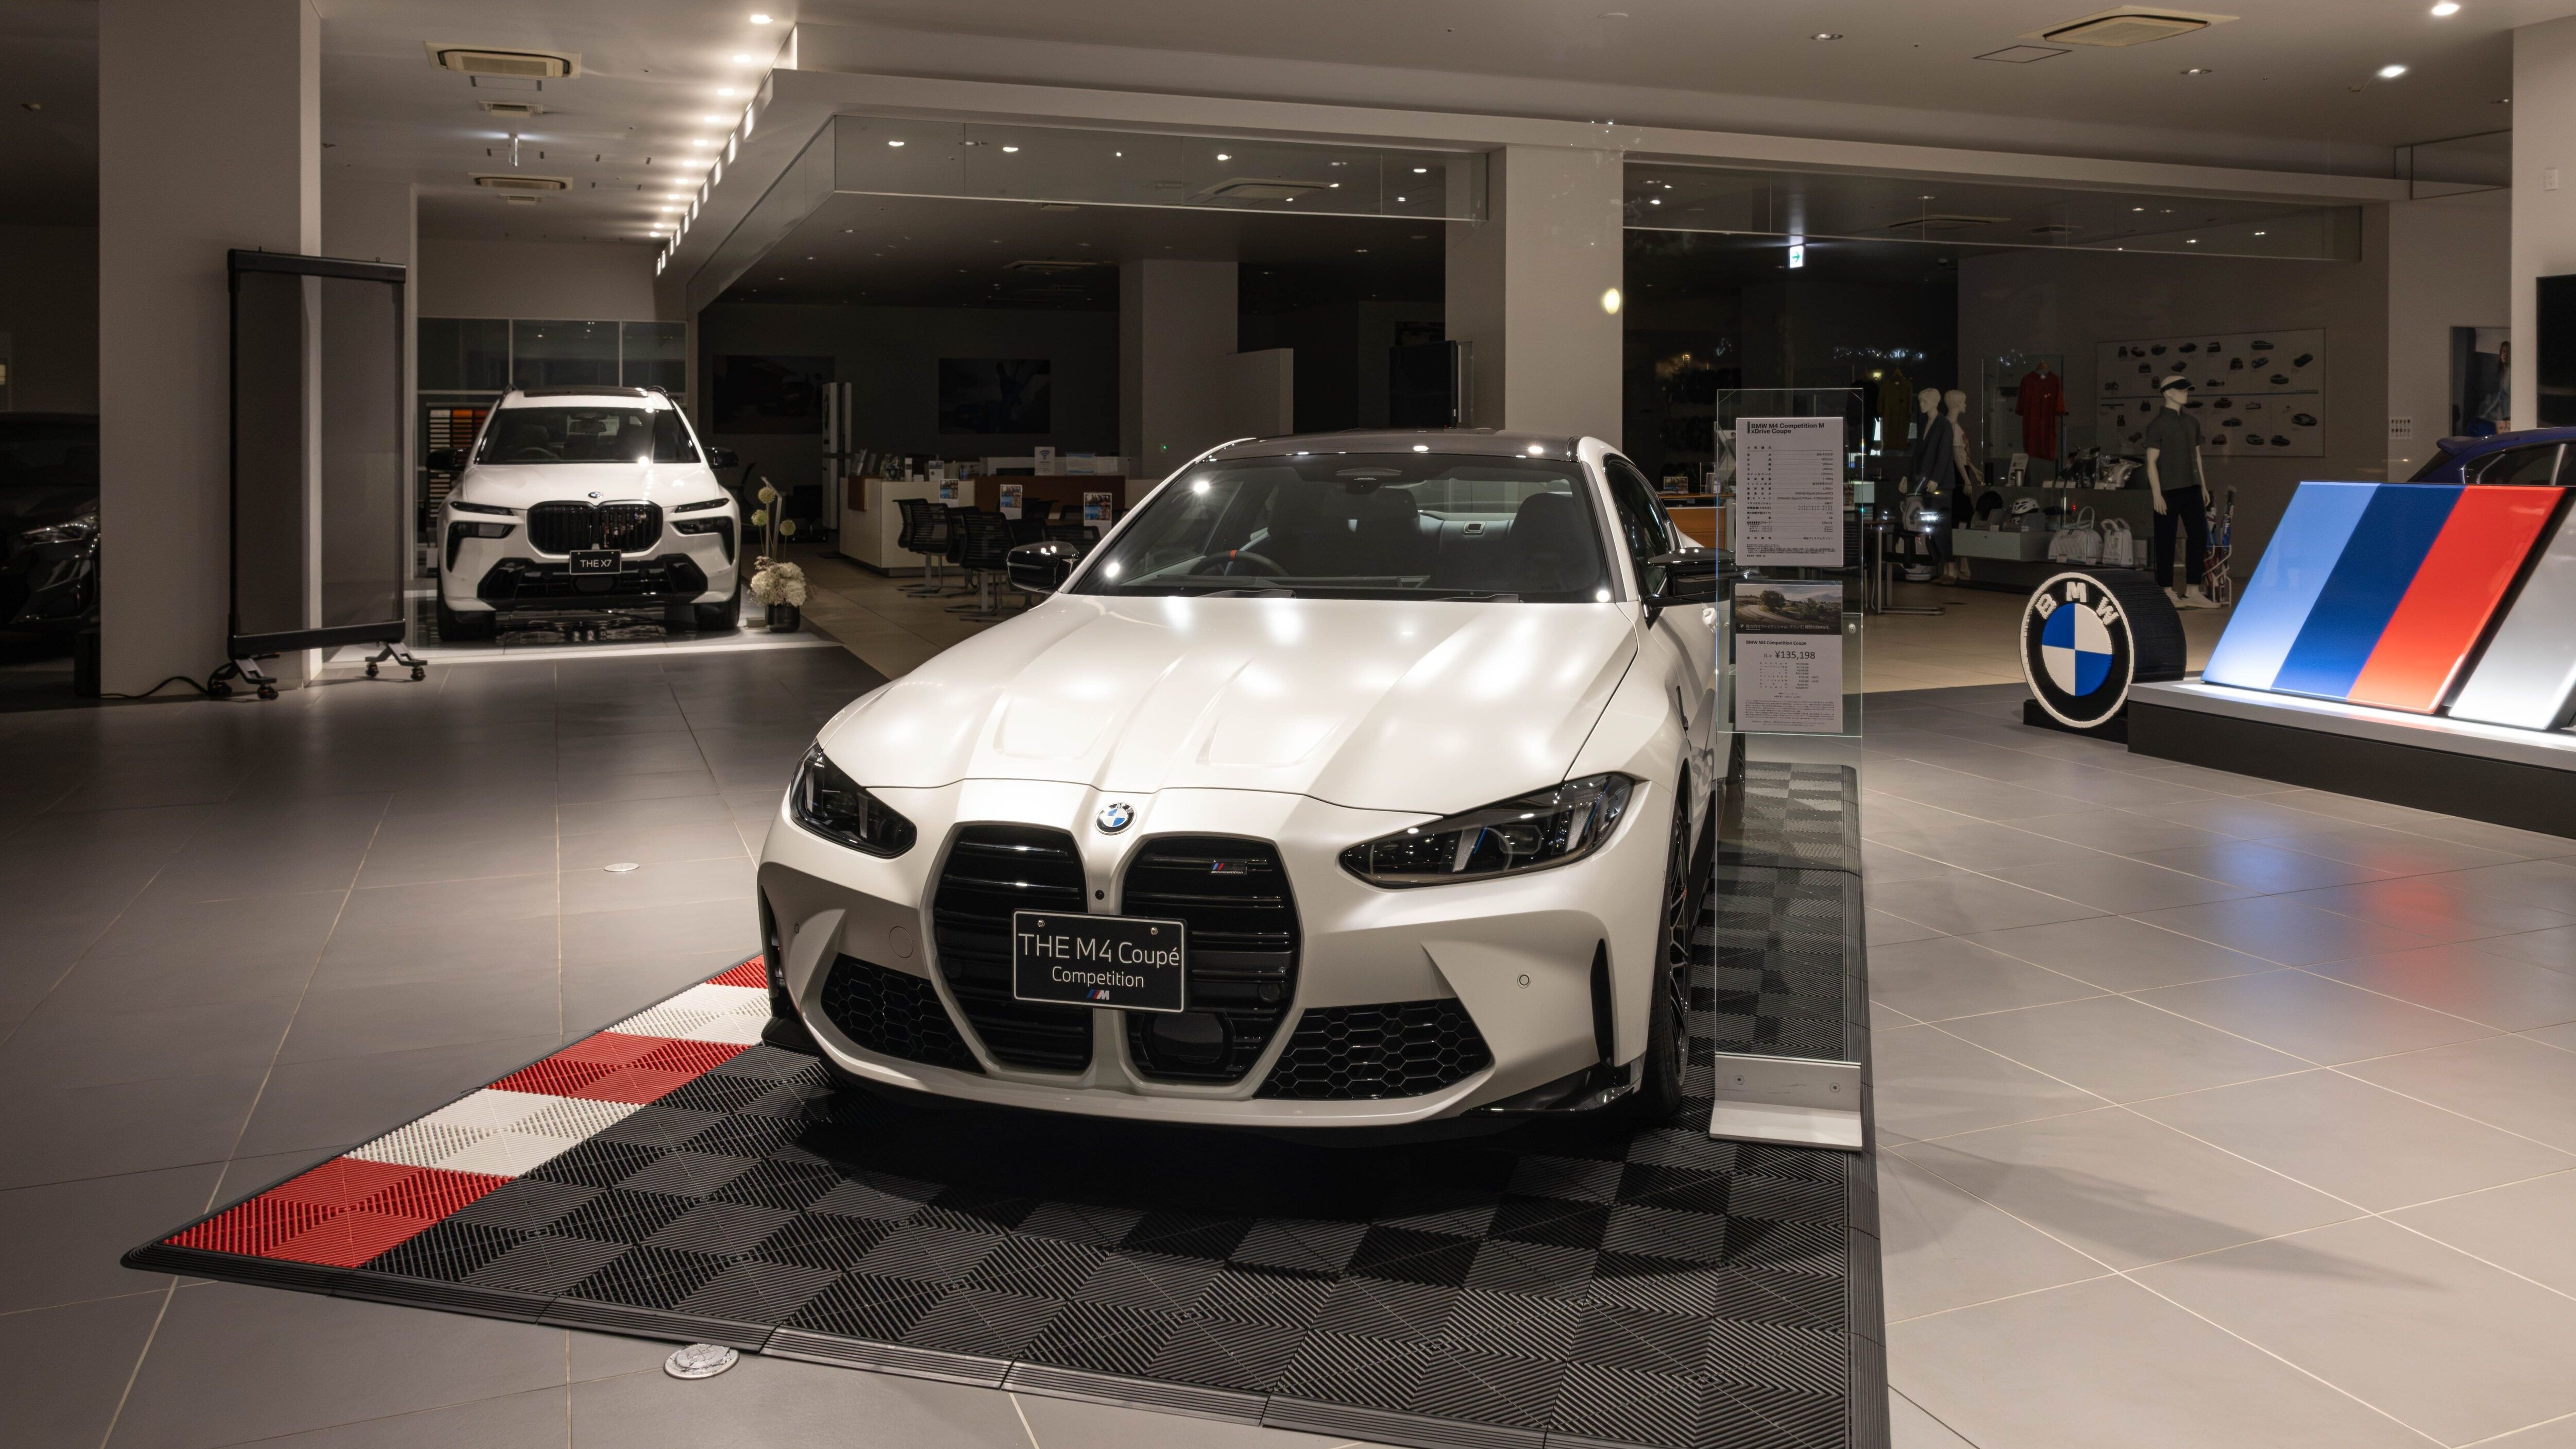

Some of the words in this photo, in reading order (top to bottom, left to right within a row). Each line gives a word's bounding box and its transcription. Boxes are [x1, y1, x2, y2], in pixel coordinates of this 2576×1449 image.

[2035, 581, 2121, 626] BMW
[1775, 651, 1815, 660] ¥135,198
[1019, 933, 1070, 959] THE
[1077, 939, 1111, 963] M4
[1118, 942, 1180, 969] Coupé
[1052, 966, 1144, 988] Competition
